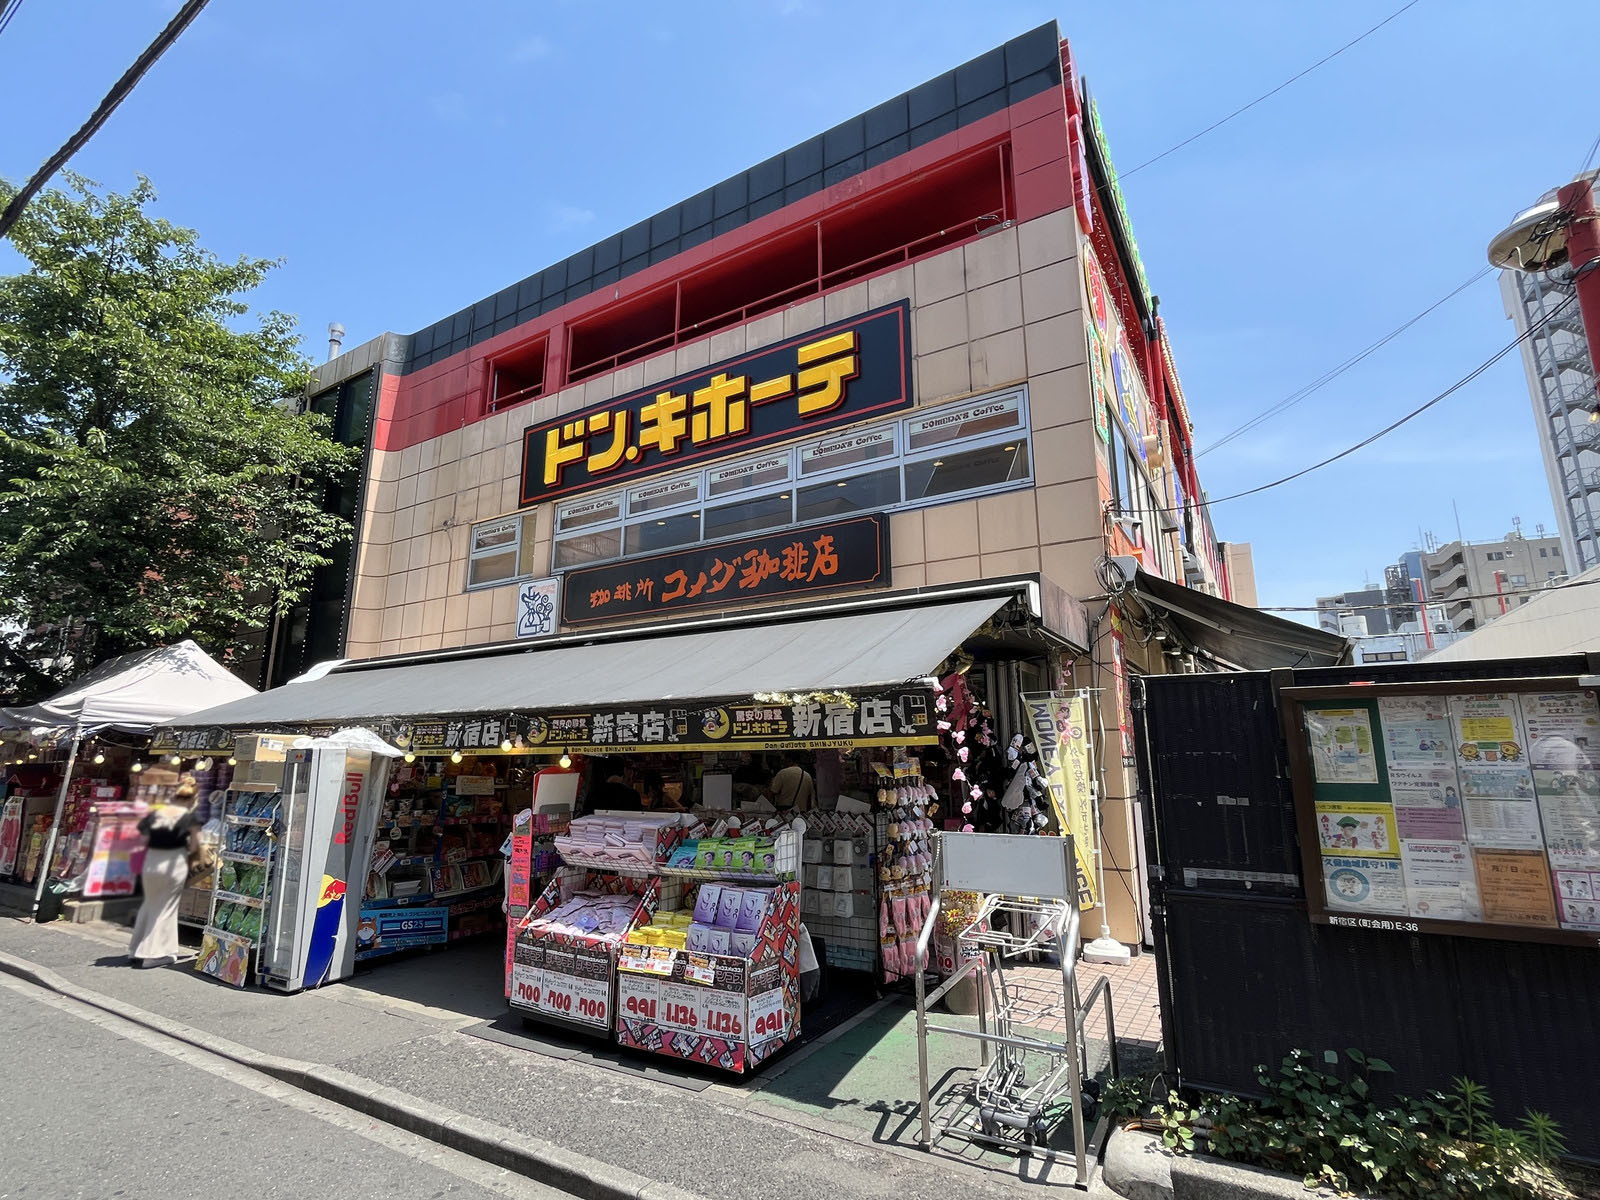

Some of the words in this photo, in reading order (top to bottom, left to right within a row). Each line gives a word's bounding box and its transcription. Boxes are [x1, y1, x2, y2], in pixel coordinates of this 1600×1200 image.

[592, 710, 665, 743] 新宿店
[792, 699, 893, 738] 新宿店
[445, 720, 501, 747] 新宿店
[401, 920, 424, 930] GS25
[518, 981, 541, 1003] 700
[548, 989, 572, 1012] 700
[579, 997, 606, 1019] 700
[627, 995, 657, 1018] 991
[755, 1008, 783, 1036] 991
